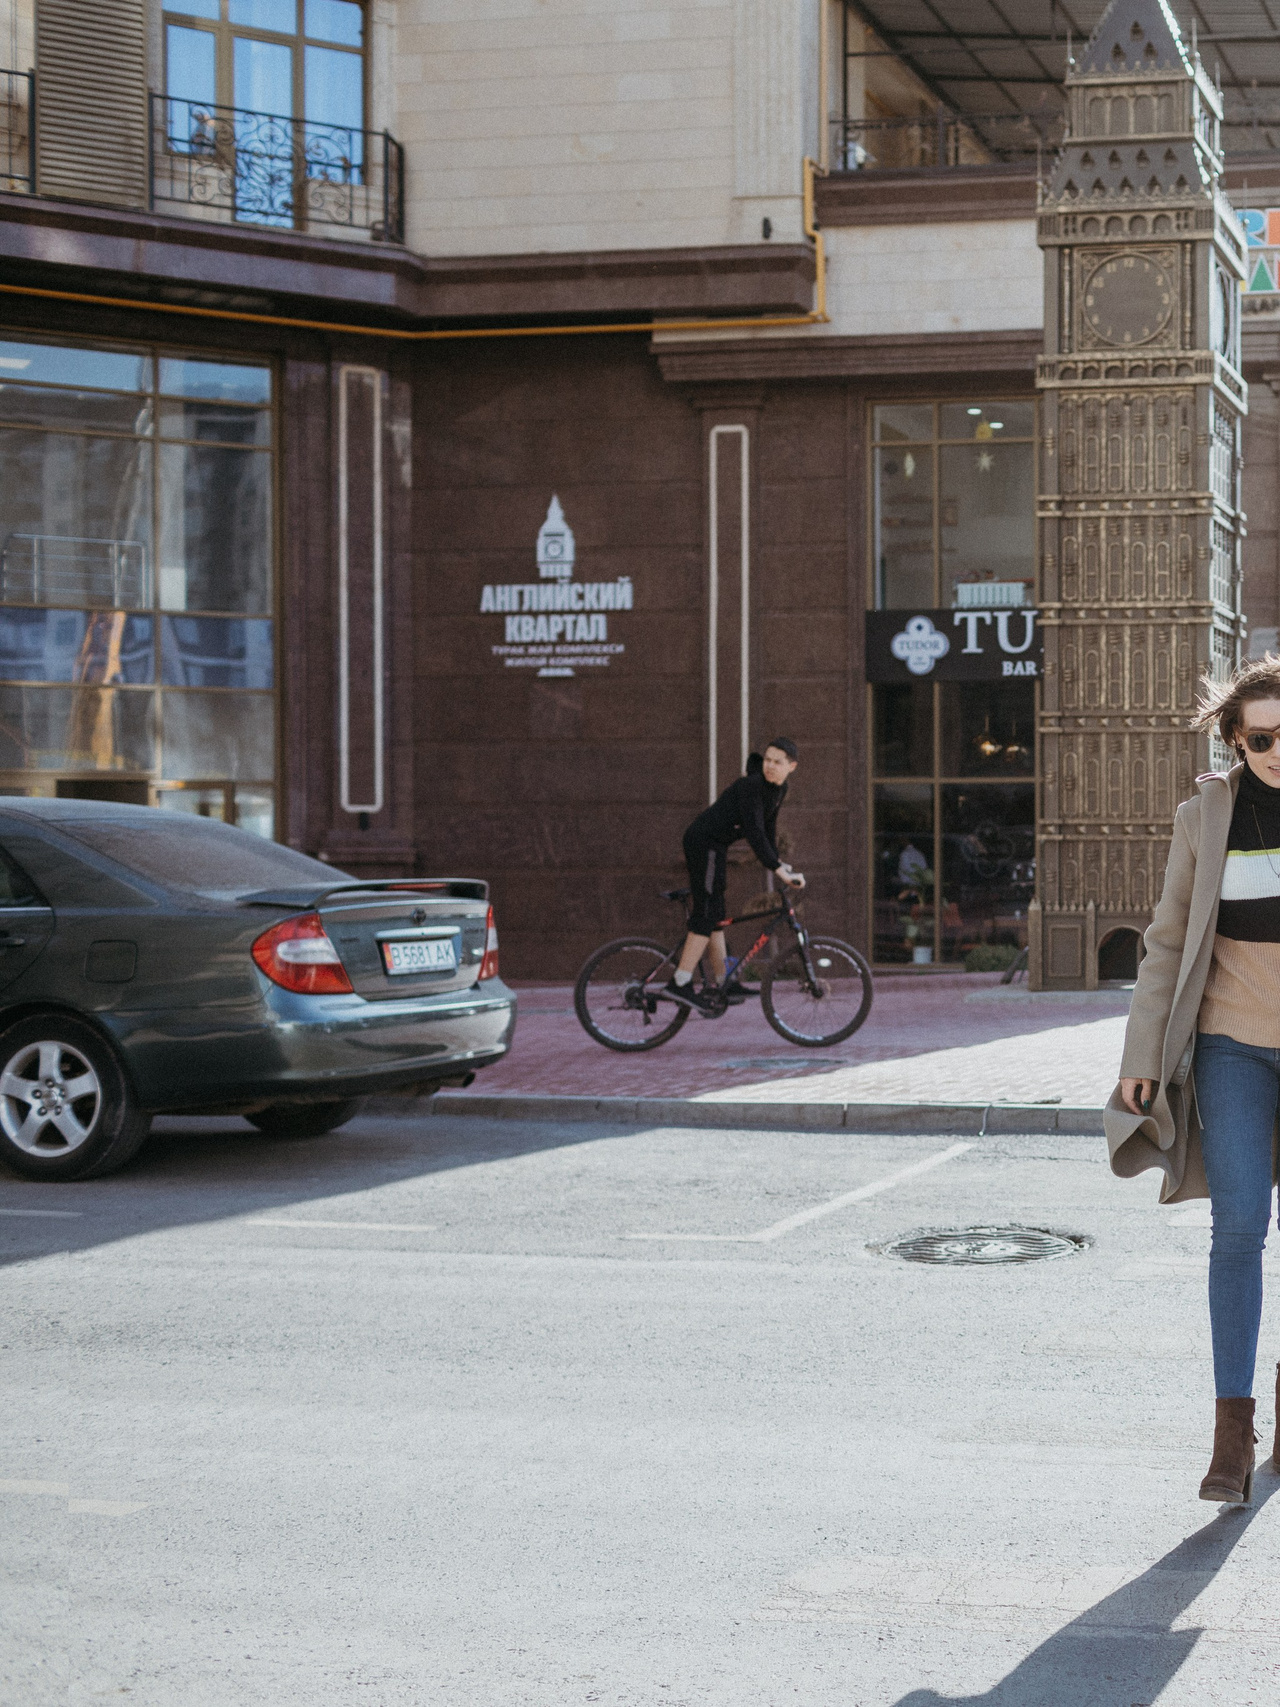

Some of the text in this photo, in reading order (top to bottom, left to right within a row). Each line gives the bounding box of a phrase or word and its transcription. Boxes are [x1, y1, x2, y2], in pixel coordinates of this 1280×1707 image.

[480, 576, 633, 613] АНГЛИЙСКИЙ
[505, 614, 607, 643] КВАРТАЛ
[953, 610, 1044, 654] TU
[899, 640, 940, 651] TUDOR
[548, 655, 610, 667] КОМПЛЕКС
[1002, 660, 1038, 676] BAR
[404, 945, 432, 965] 5681
[436, 944, 455, 961] AK
